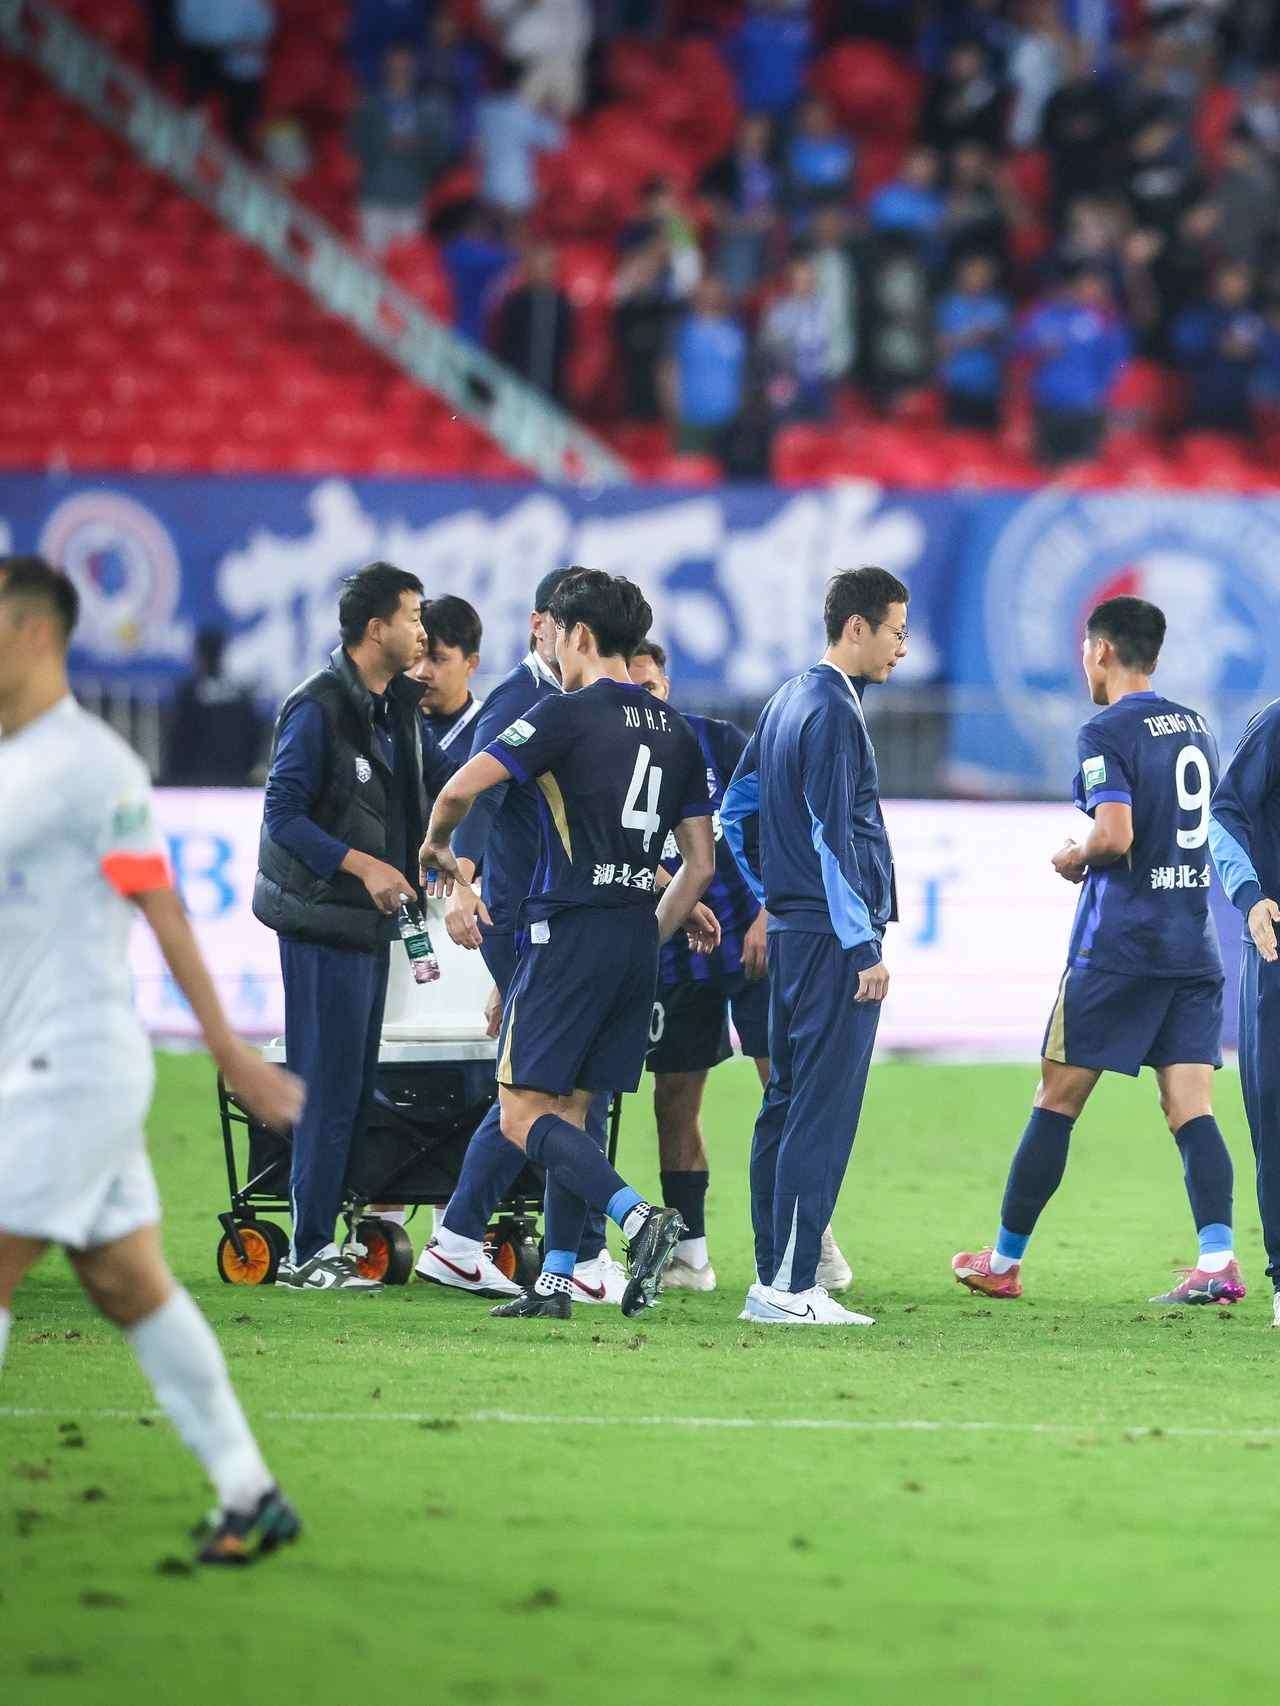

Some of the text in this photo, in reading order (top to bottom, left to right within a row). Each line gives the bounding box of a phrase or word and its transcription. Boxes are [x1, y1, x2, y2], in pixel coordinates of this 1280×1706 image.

[622, 705, 672, 733] XU H.F.
[1143, 713, 1187, 737] ZHENG
[621, 743, 663, 853] 4
[1175, 744, 1212, 850] 9
